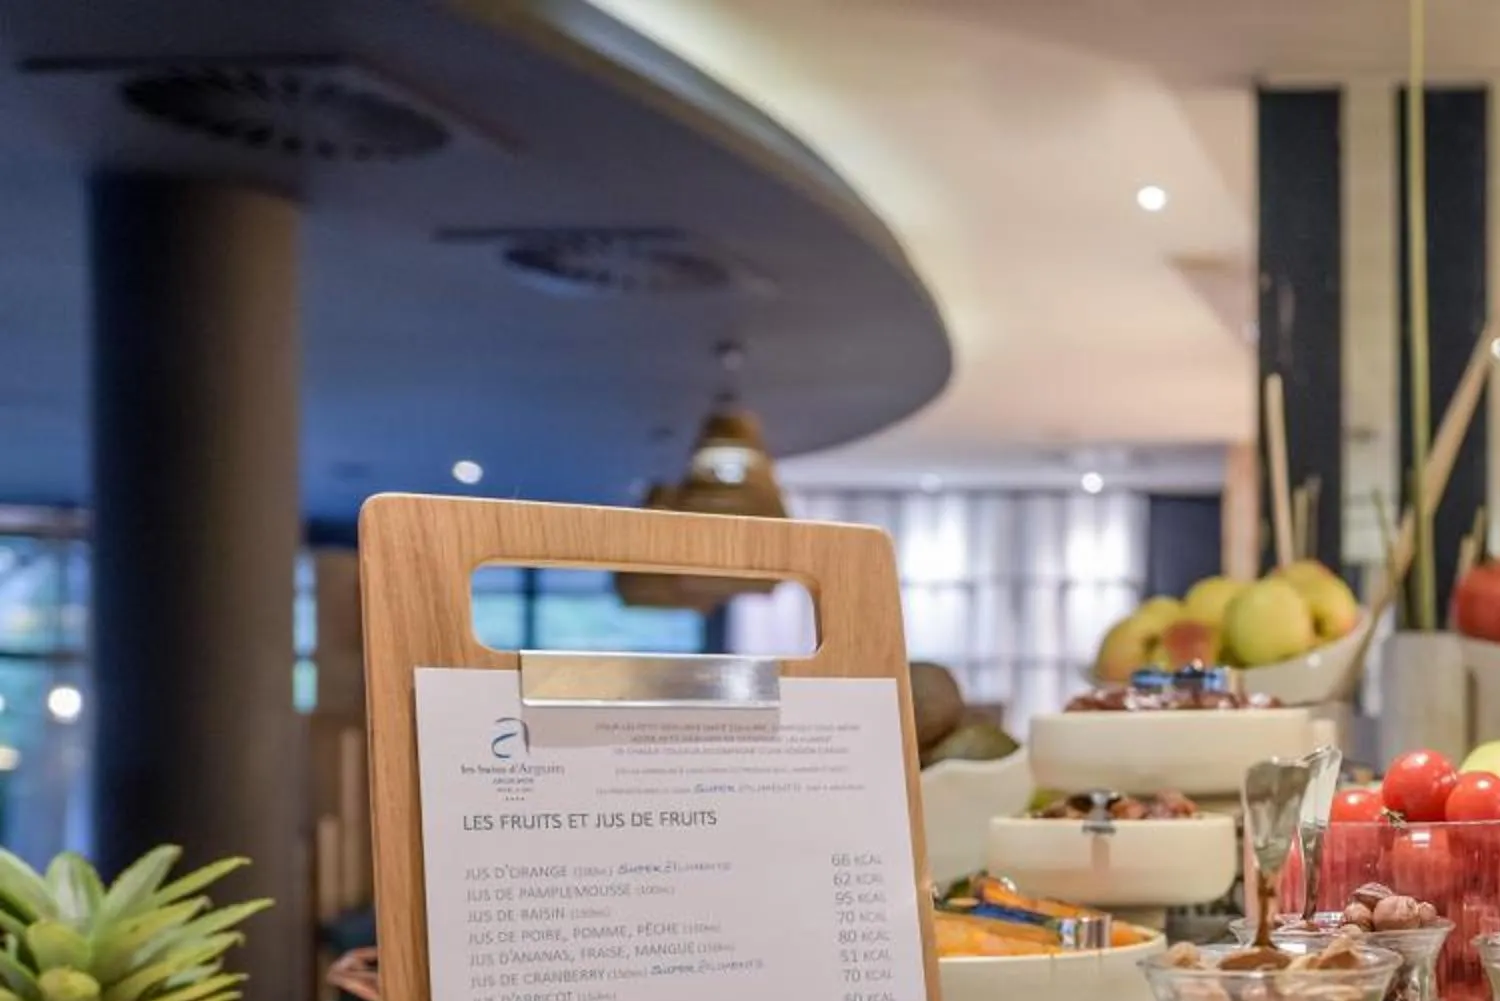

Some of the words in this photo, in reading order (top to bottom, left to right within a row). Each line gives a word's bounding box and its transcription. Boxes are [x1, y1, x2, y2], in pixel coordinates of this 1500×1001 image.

[463, 815, 493, 832] LES
[500, 813, 562, 831] FRUITS
[568, 813, 589, 829] ET
[595, 811, 625, 829] JUS
[631, 811, 653, 828] DE
[659, 810, 717, 827] FRUITS
[465, 867, 490, 881] JUS
[495, 863, 567, 879] D'ORANGE
[466, 888, 491, 902] JUS
[495, 887, 512, 901] DE
[518, 884, 630, 900] PAMPLEMOUSSE
[467, 910, 492, 924] JUS
[496, 909, 514, 922] DE
[520, 907, 565, 921] RAISIN
[468, 931, 493, 946] JUS
[497, 930, 516, 944] DE
[573, 925, 632, 941] POMME,
[470, 953, 495, 968] JUS
[499, 949, 575, 967] D'ANANAS,
[580, 945, 631, 962] FRAISE,
[634, 941, 695, 958] MANGUE
[470, 974, 496, 989] JUS
[500, 972, 518, 987] DE
[523, 968, 607, 986] CRANBERRY
[843, 968, 861, 982] 70
